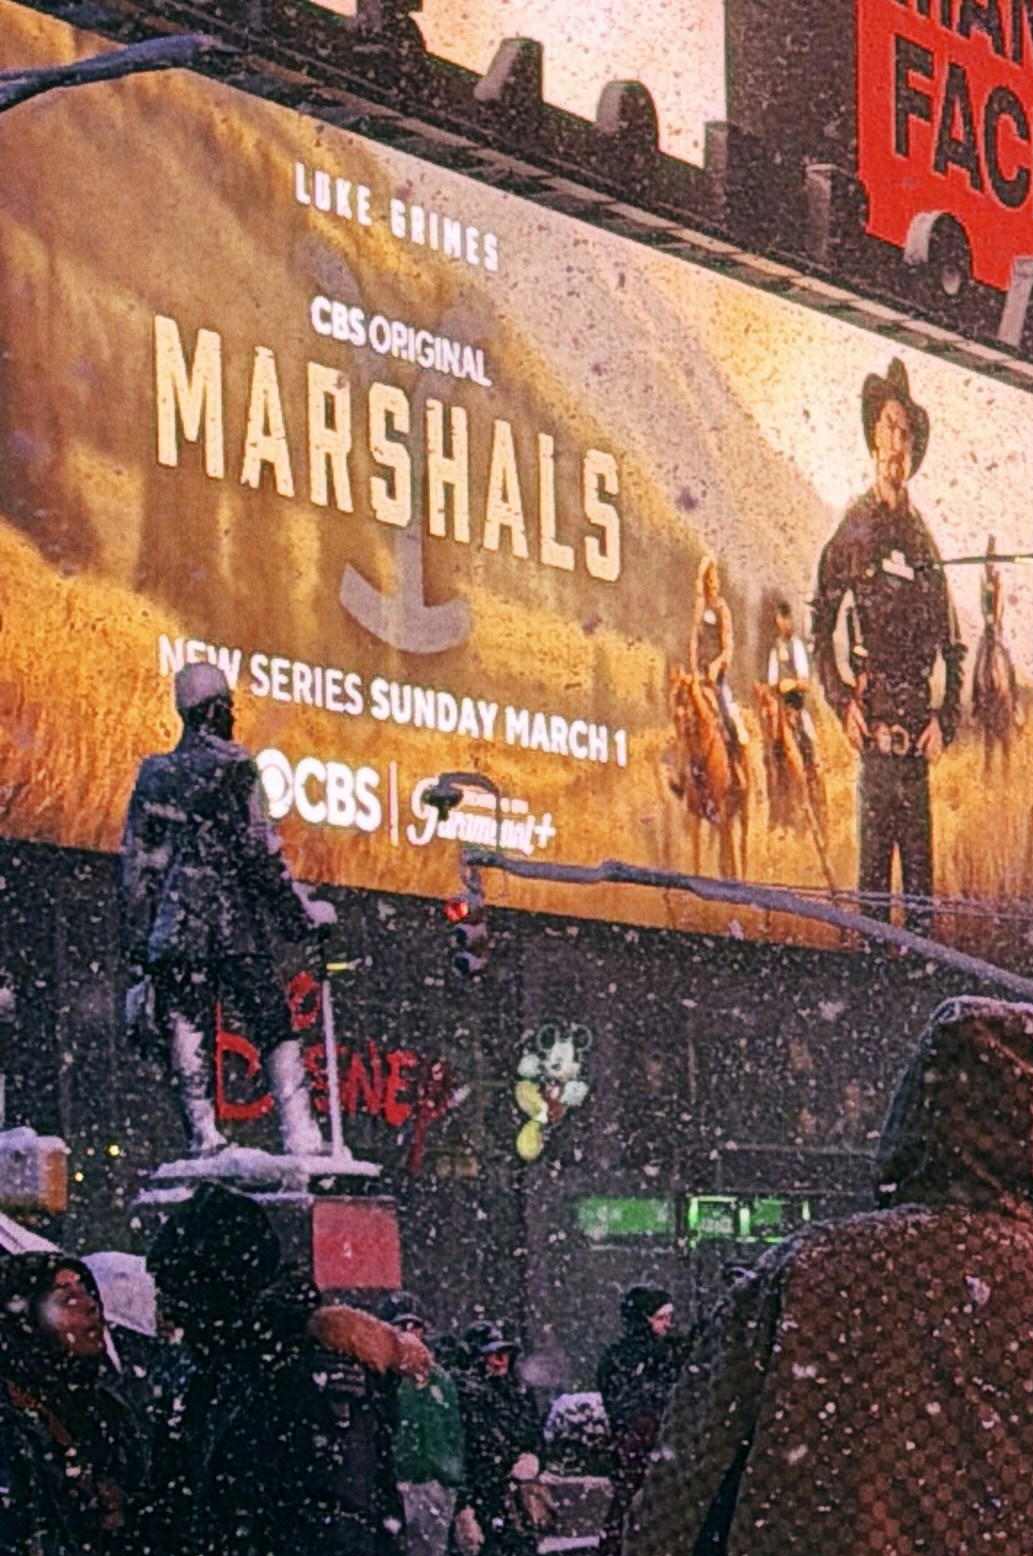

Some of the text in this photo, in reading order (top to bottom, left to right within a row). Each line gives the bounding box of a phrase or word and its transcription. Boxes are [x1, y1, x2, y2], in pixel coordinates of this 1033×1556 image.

[295, 161, 499, 272] LUKE GRIMES
[310, 295, 493, 388] CBS ORIGINAL
[154, 315, 623, 581] MARSHALS
[158, 635, 627, 768] NEW SERIES SUNDAY MARCH 1
[294, 755, 382, 833] CBS
[213, 970, 452, 1177] DSNEY
